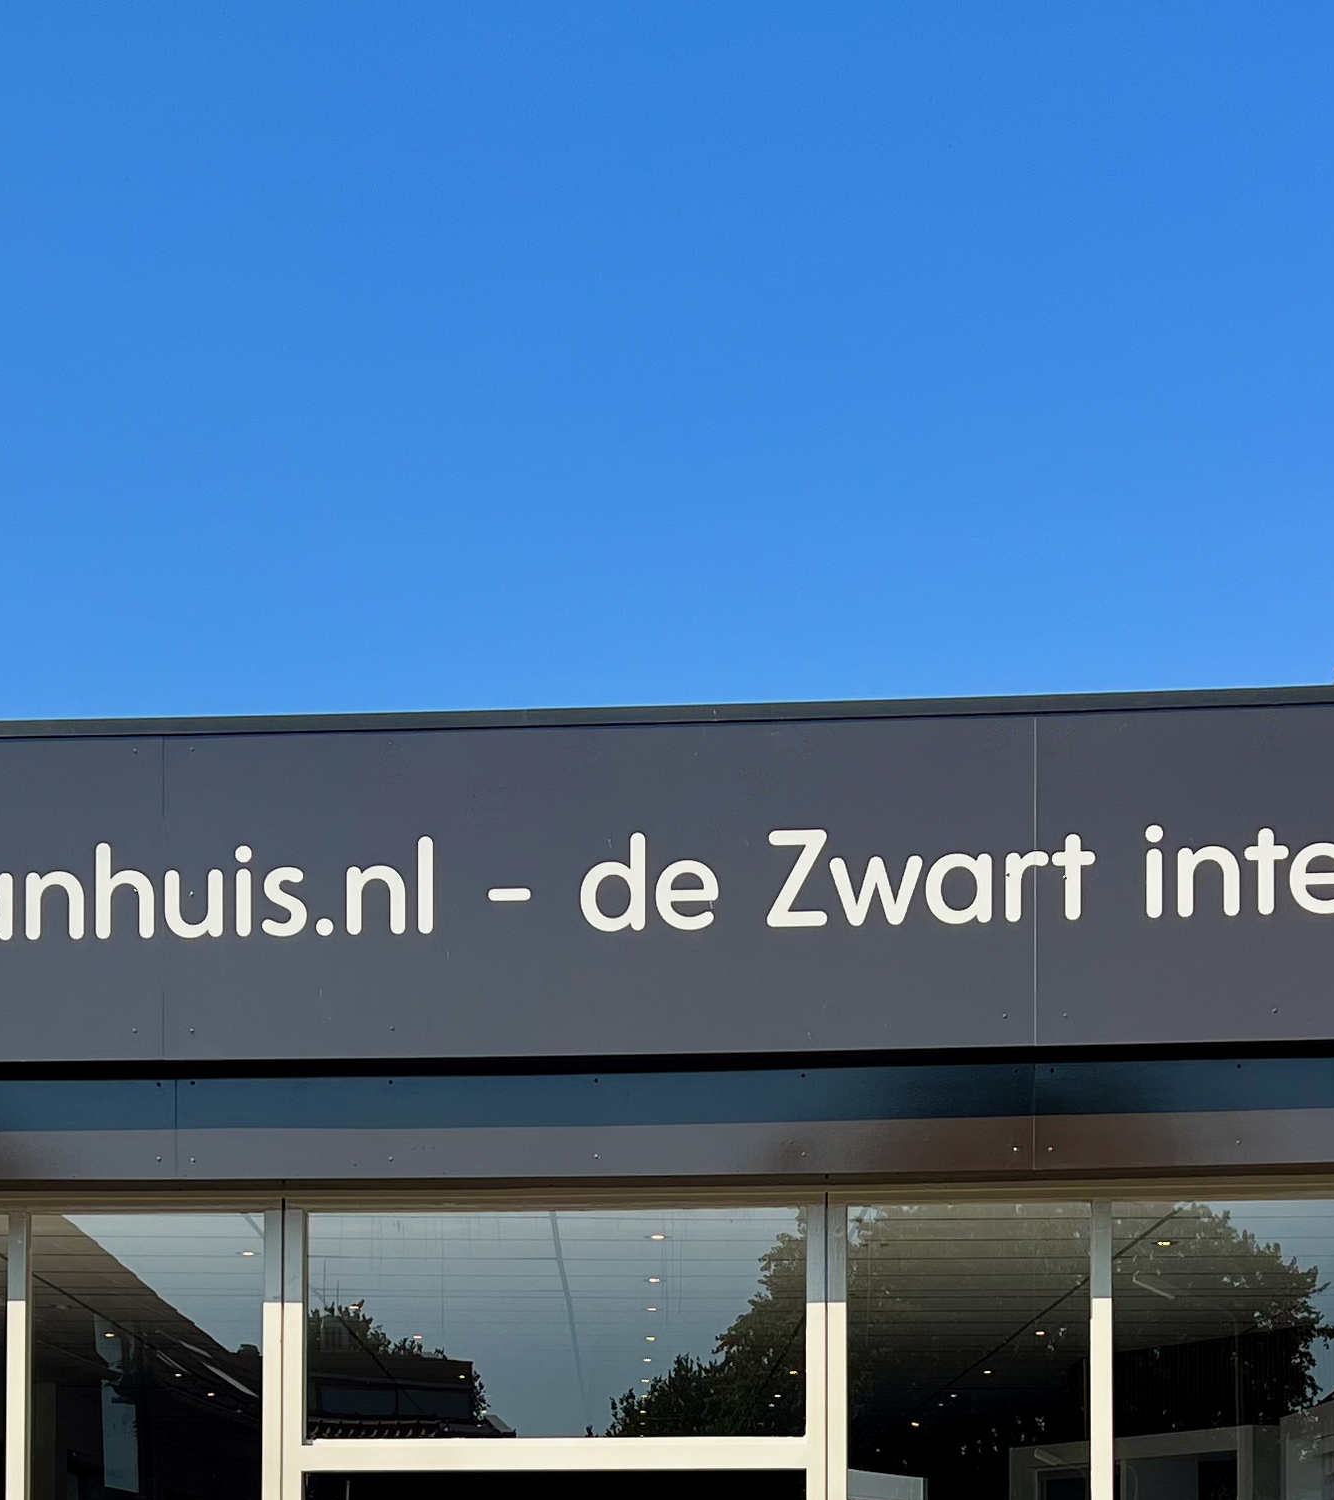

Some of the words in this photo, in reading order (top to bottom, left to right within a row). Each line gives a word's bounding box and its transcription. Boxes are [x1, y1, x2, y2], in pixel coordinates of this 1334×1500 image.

[487, 886, 531, 902] -
[580, 832, 719, 932] de
[766, 829, 1096, 928] Zwart
